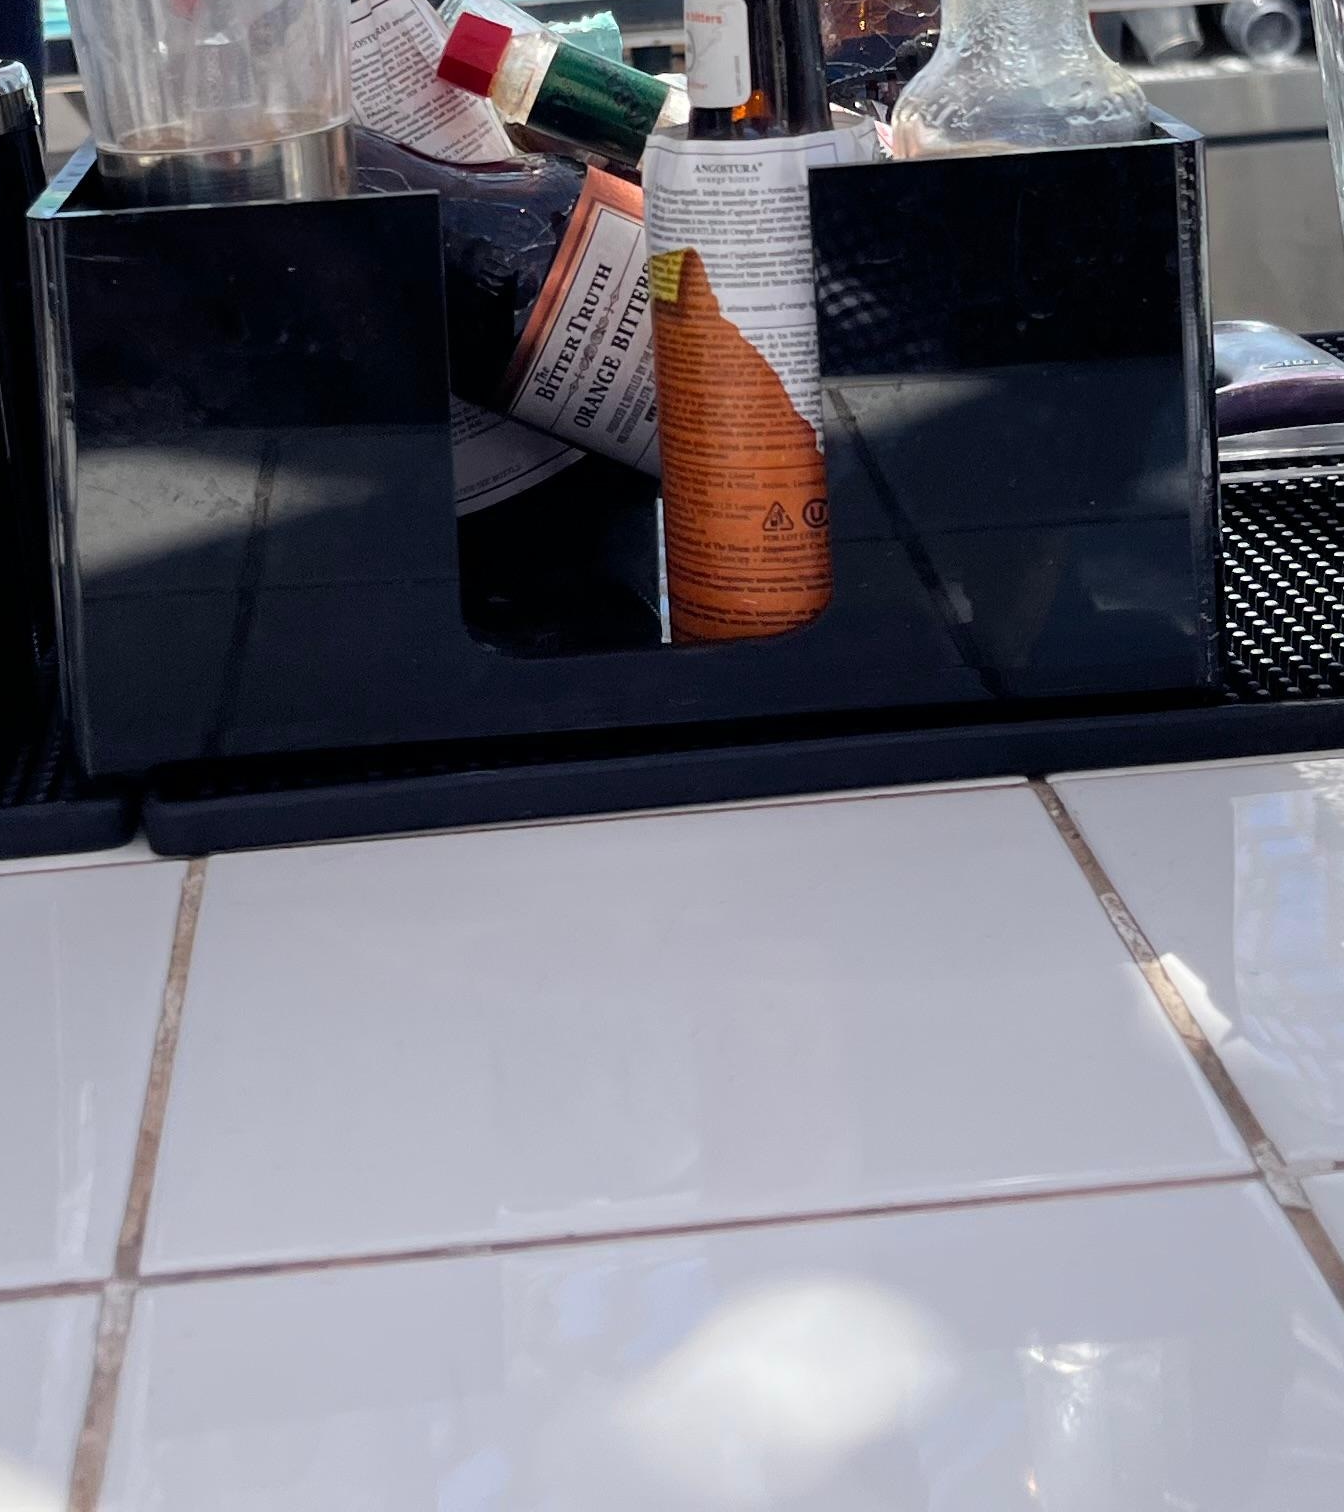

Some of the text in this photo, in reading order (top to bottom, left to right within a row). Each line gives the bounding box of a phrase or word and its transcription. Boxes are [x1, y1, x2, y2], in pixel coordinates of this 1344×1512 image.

[535, 262, 613, 403] BITTER TRUTH
[534, 366, 551, 387] The
[573, 355, 622, 430] ORANGE
